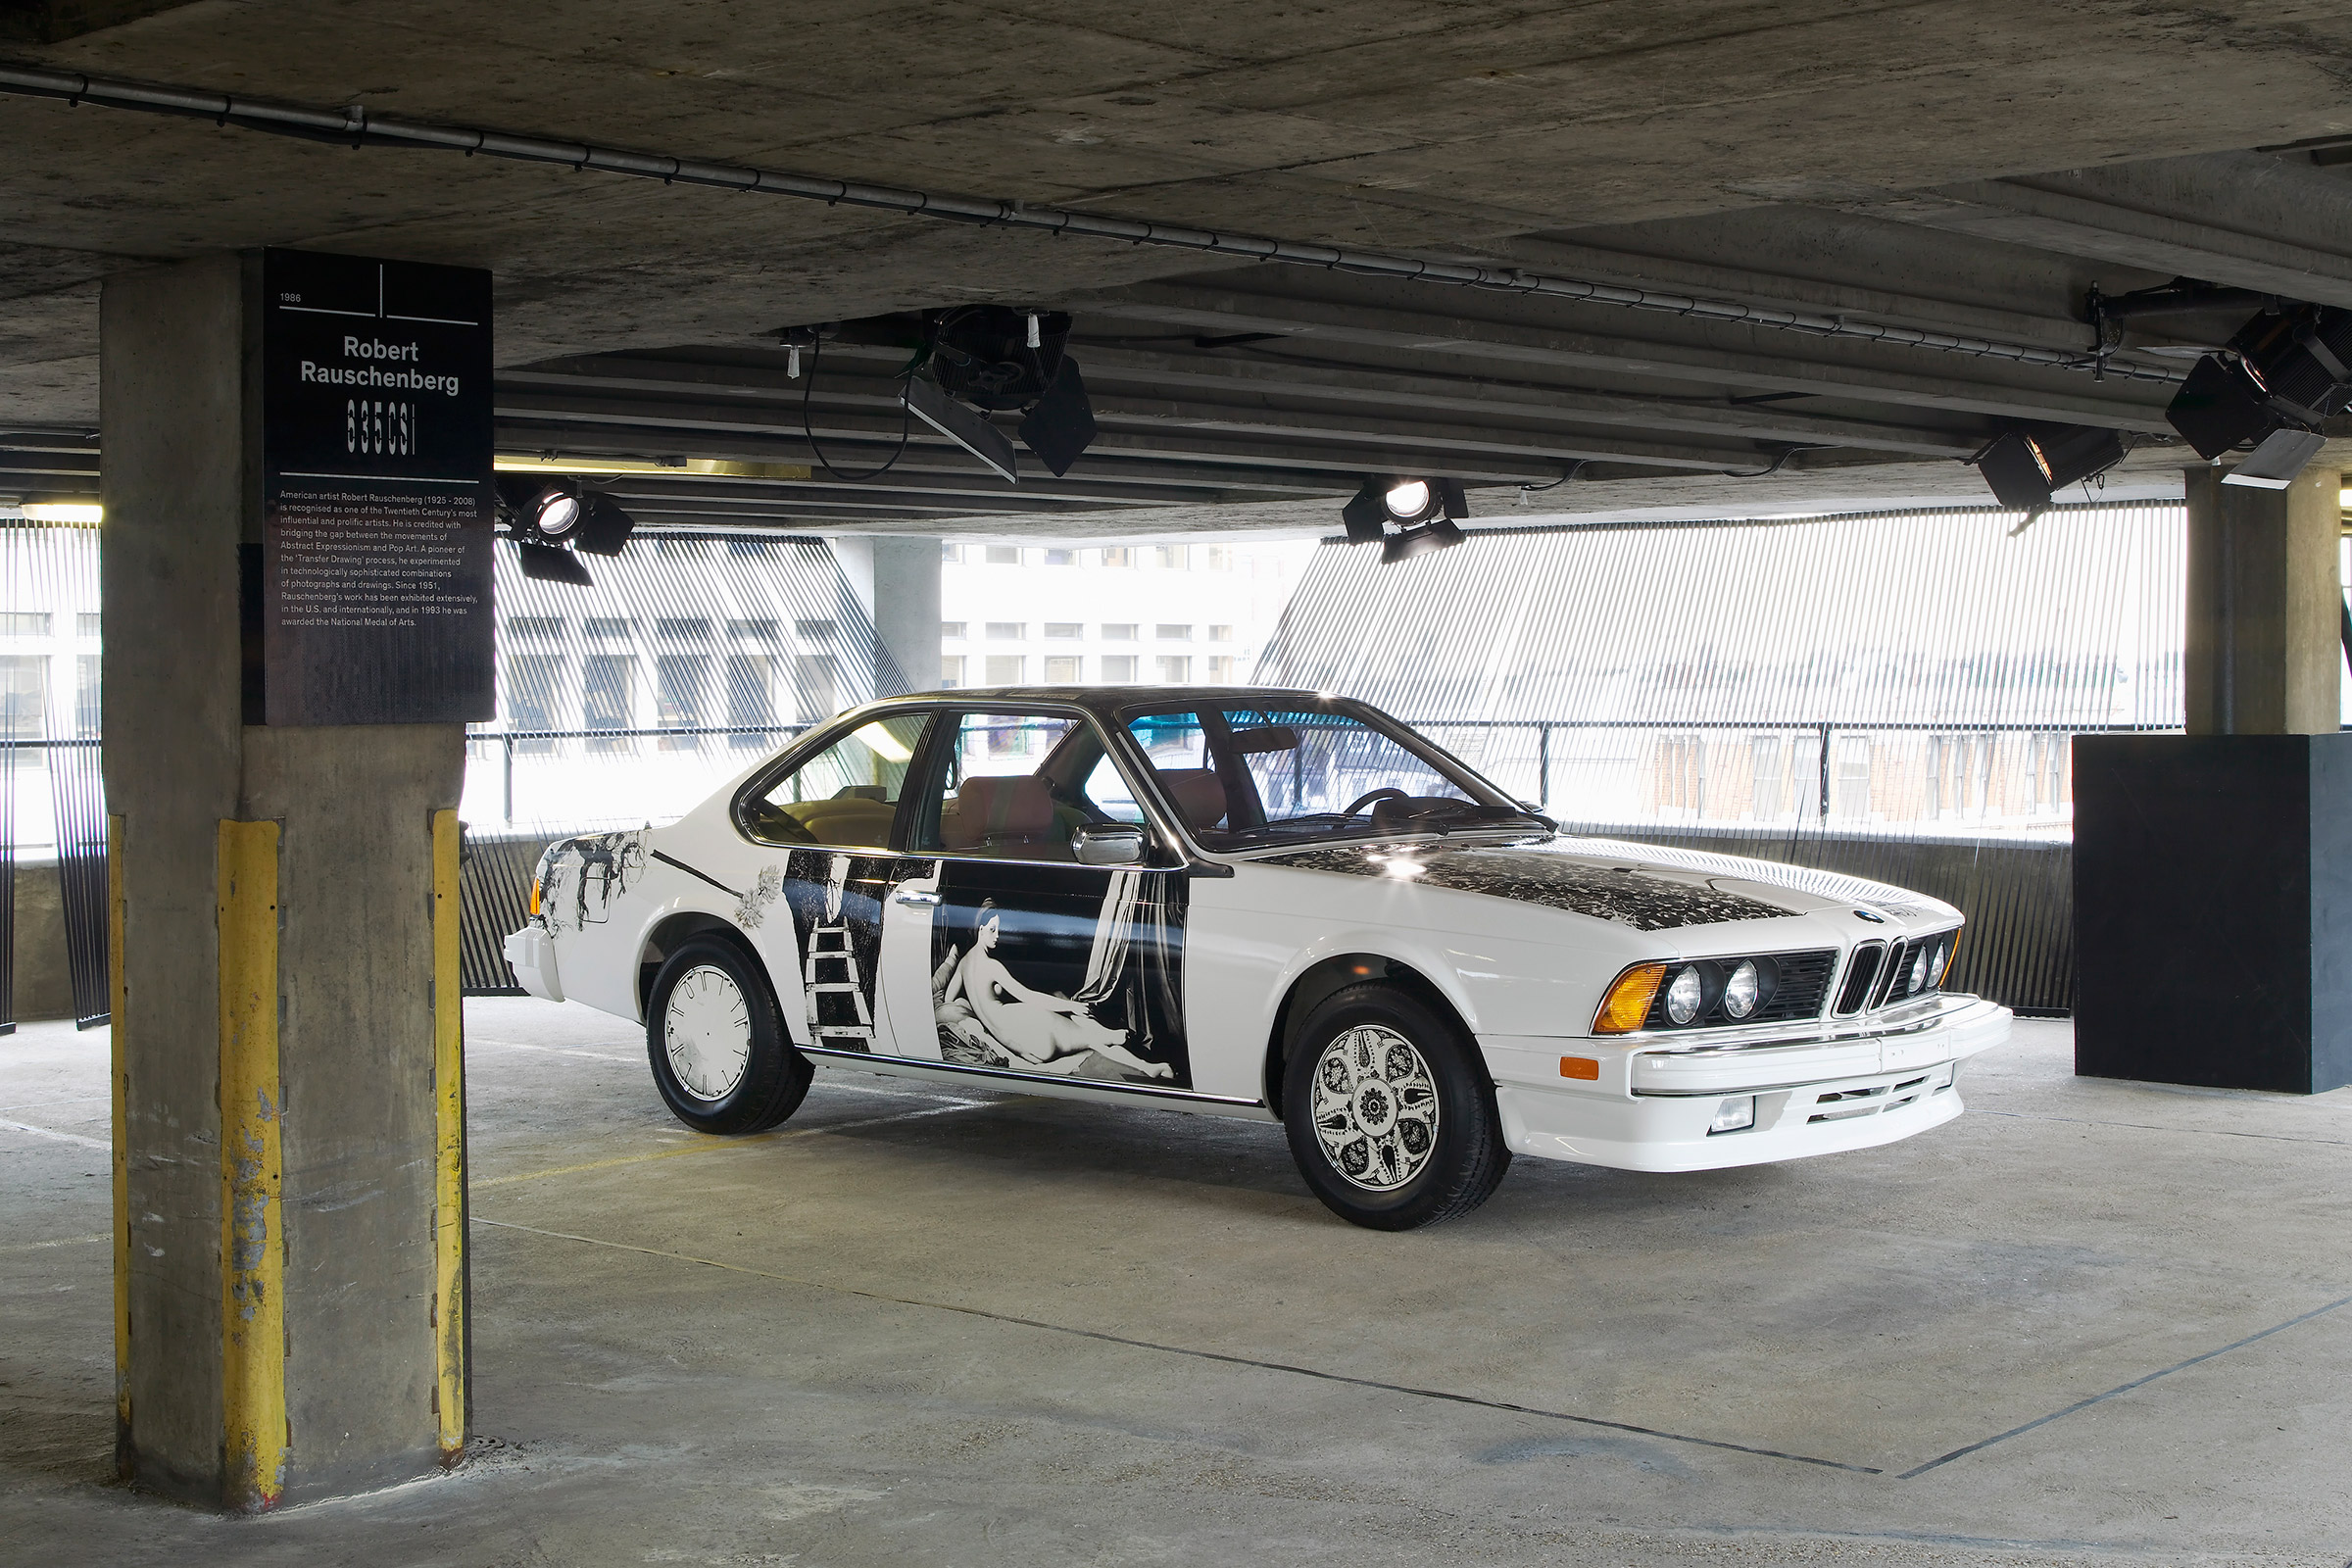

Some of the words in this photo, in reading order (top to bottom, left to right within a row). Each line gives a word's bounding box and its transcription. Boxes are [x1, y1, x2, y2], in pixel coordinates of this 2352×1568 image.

[280, 293, 301, 302] 1986
[344, 336, 419, 361] Robert
[301, 361, 459, 396] Rauschenberg
[280, 491, 317, 499] American
[341, 493, 368, 502] Robert
[369, 494, 423, 505] Rauschenberg
[453, 497, 475, 506] 2008)
[289, 505, 331, 514] recognised
[370, 506, 382, 514] the
[384, 507, 420, 515] Twentieth
[280, 516, 319, 524] influential
[337, 518, 363, 527] prolific
[281, 529, 313, 538] bridging
[281, 542, 314, 550] Abstract
[316, 542, 371, 552] Expressionism
[389, 544, 404, 553] Pop
[428, 545, 456, 554] pioneer
[366, 557, 397, 566] process,
[410, 558, 460, 567] experimented
[290, 567, 348, 577] technologically
[349, 568, 400, 577] sophisticated
[402, 570, 451, 578] combinations
[291, 580, 340, 590] photographs
[358, 581, 394, 591] drawings.
[419, 582, 440, 591] 1951,
[436, 595, 478, 604] extensively,
[339, 606, 394, 616] internationally,
